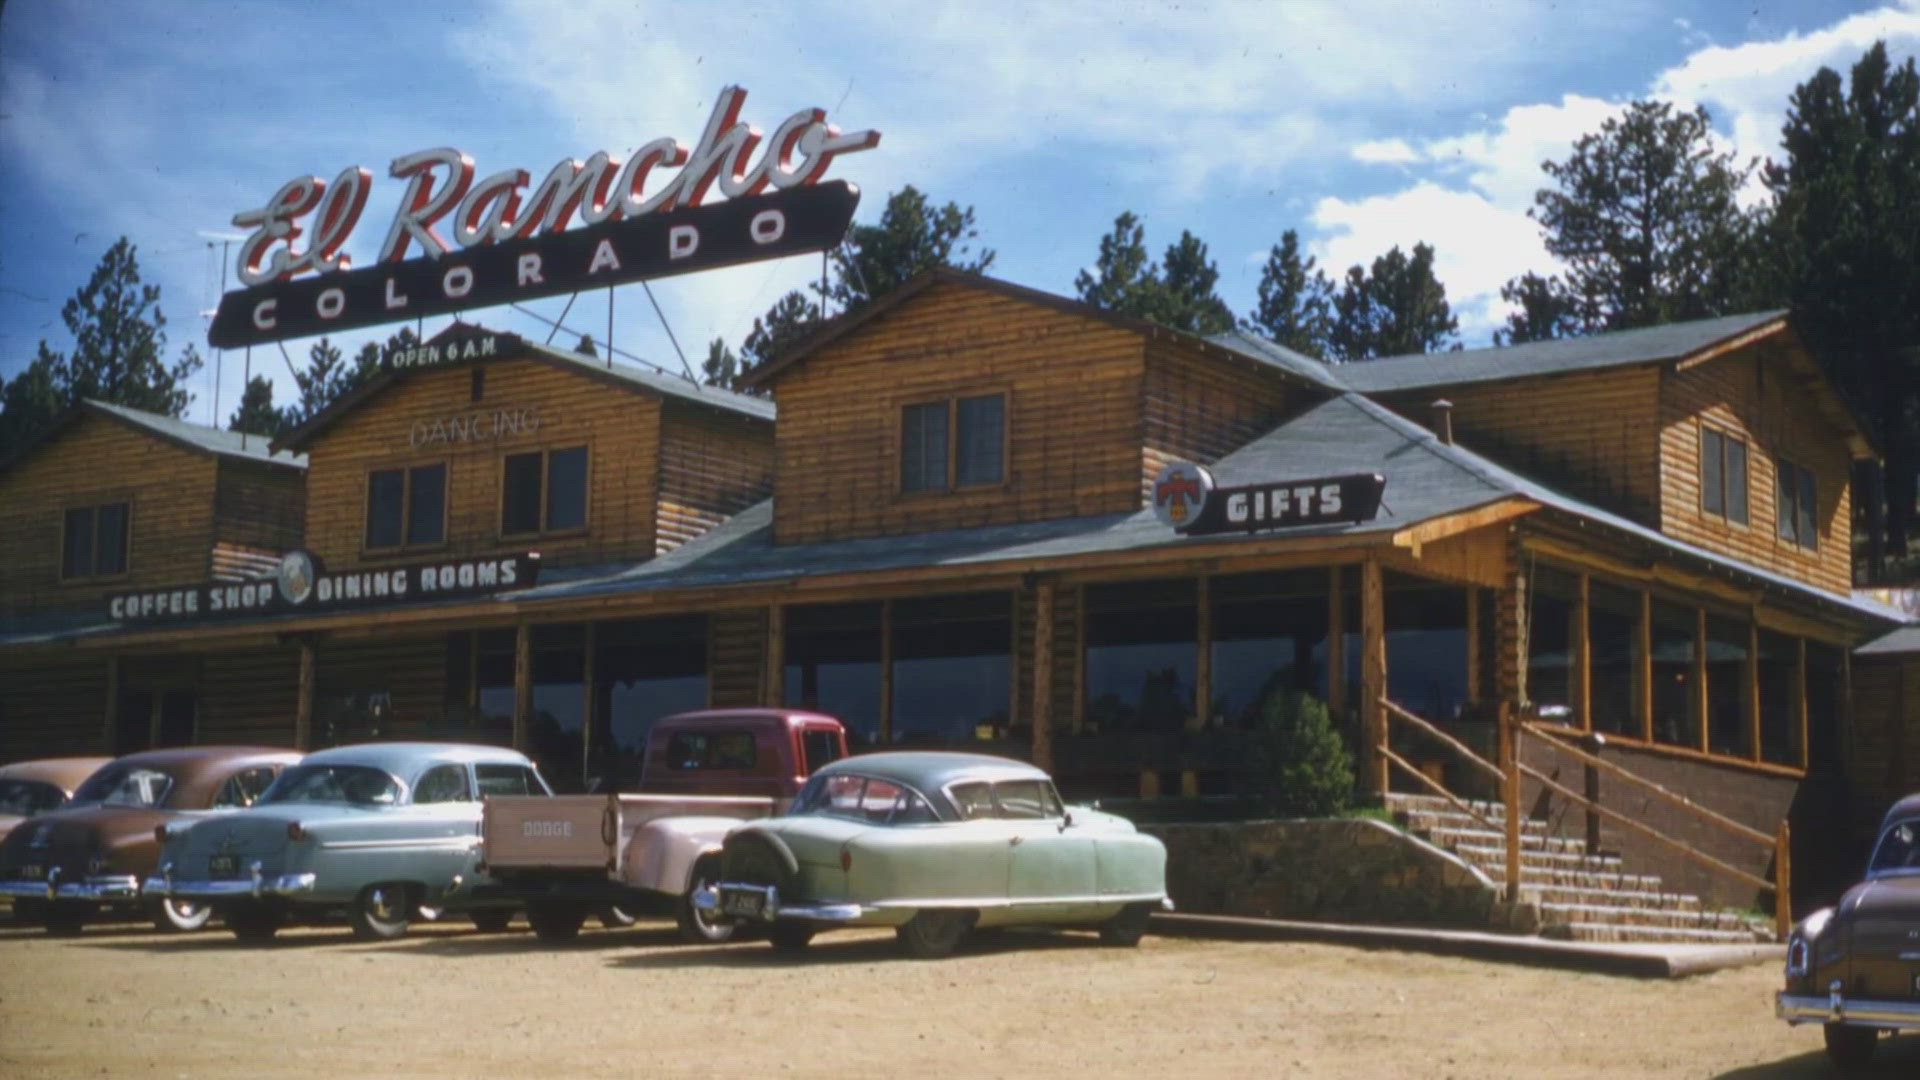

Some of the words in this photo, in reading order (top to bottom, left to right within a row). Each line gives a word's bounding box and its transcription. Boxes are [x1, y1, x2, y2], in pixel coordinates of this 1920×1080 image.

[232, 165, 372, 288] El
[378, 84, 882, 262] Rancho
[253, 209, 785, 330] COLORADO
[392, 344, 440, 368] OPEN
[447, 342, 458, 361] 6
[410, 406, 540, 448] DANCING
[1226, 484, 1343, 523] GIFTS
[317, 570, 408, 601] DINING
[420, 559, 517, 592] ROOMS
[111, 590, 198, 619] COFFEE
[210, 583, 273, 611] SHOP
[523, 820, 573, 838] DODGE
